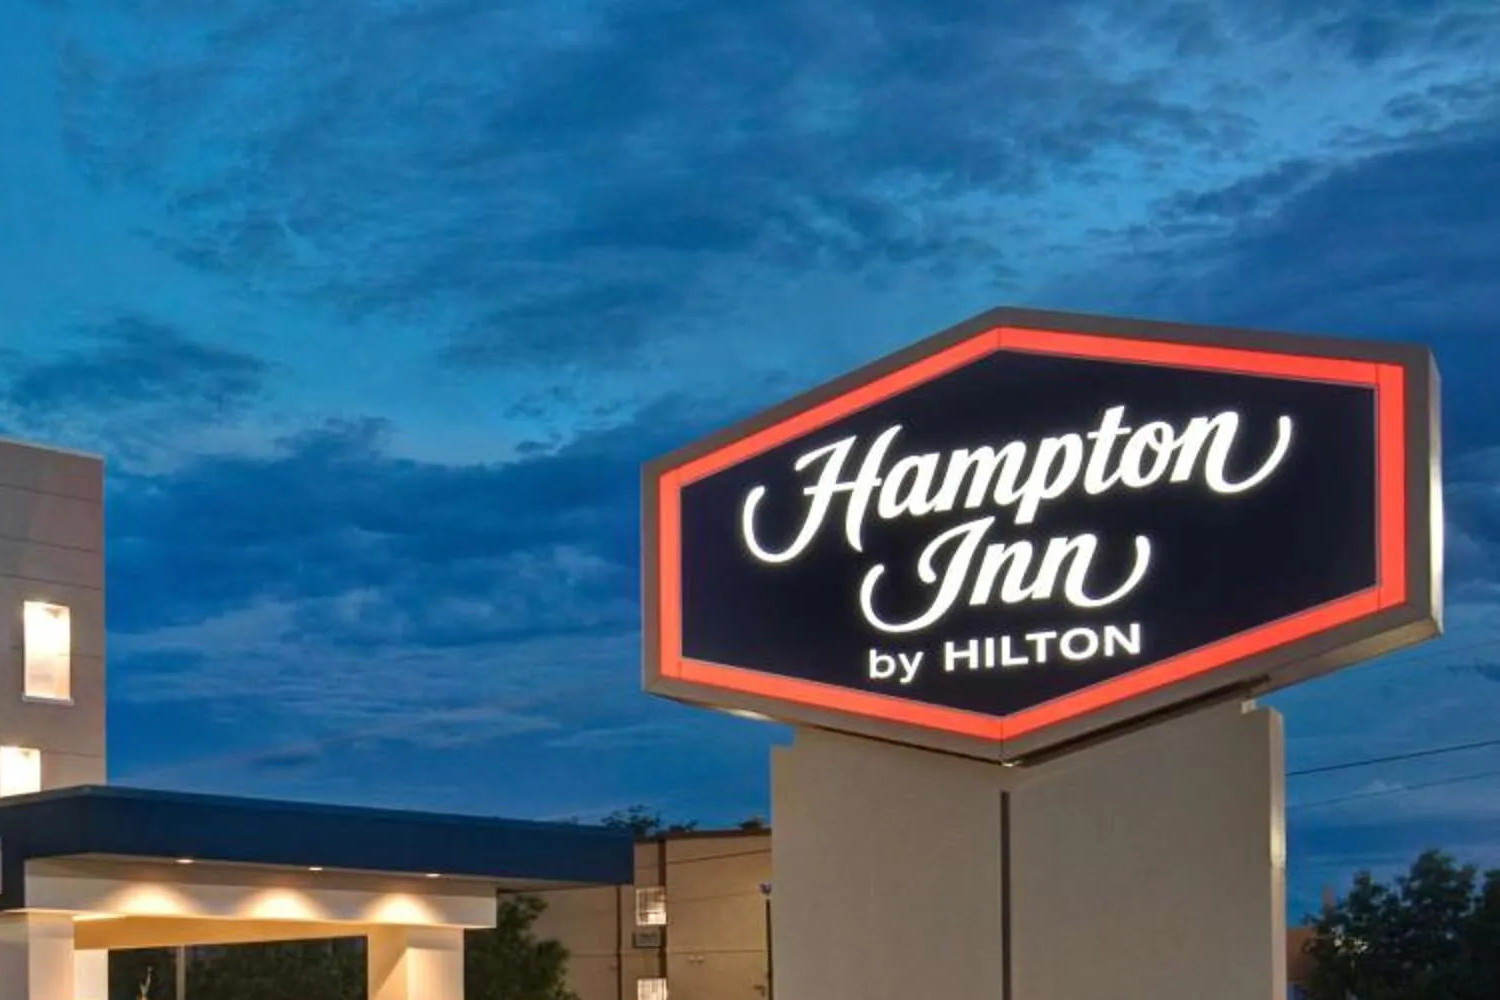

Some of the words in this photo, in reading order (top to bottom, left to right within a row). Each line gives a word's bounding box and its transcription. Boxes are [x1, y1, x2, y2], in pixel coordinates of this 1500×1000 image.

[742, 405, 1293, 563] Hampton
[859, 515, 1152, 633] Inn
[869, 648, 924, 684] by
[944, 622, 1141, 672] HILTON
